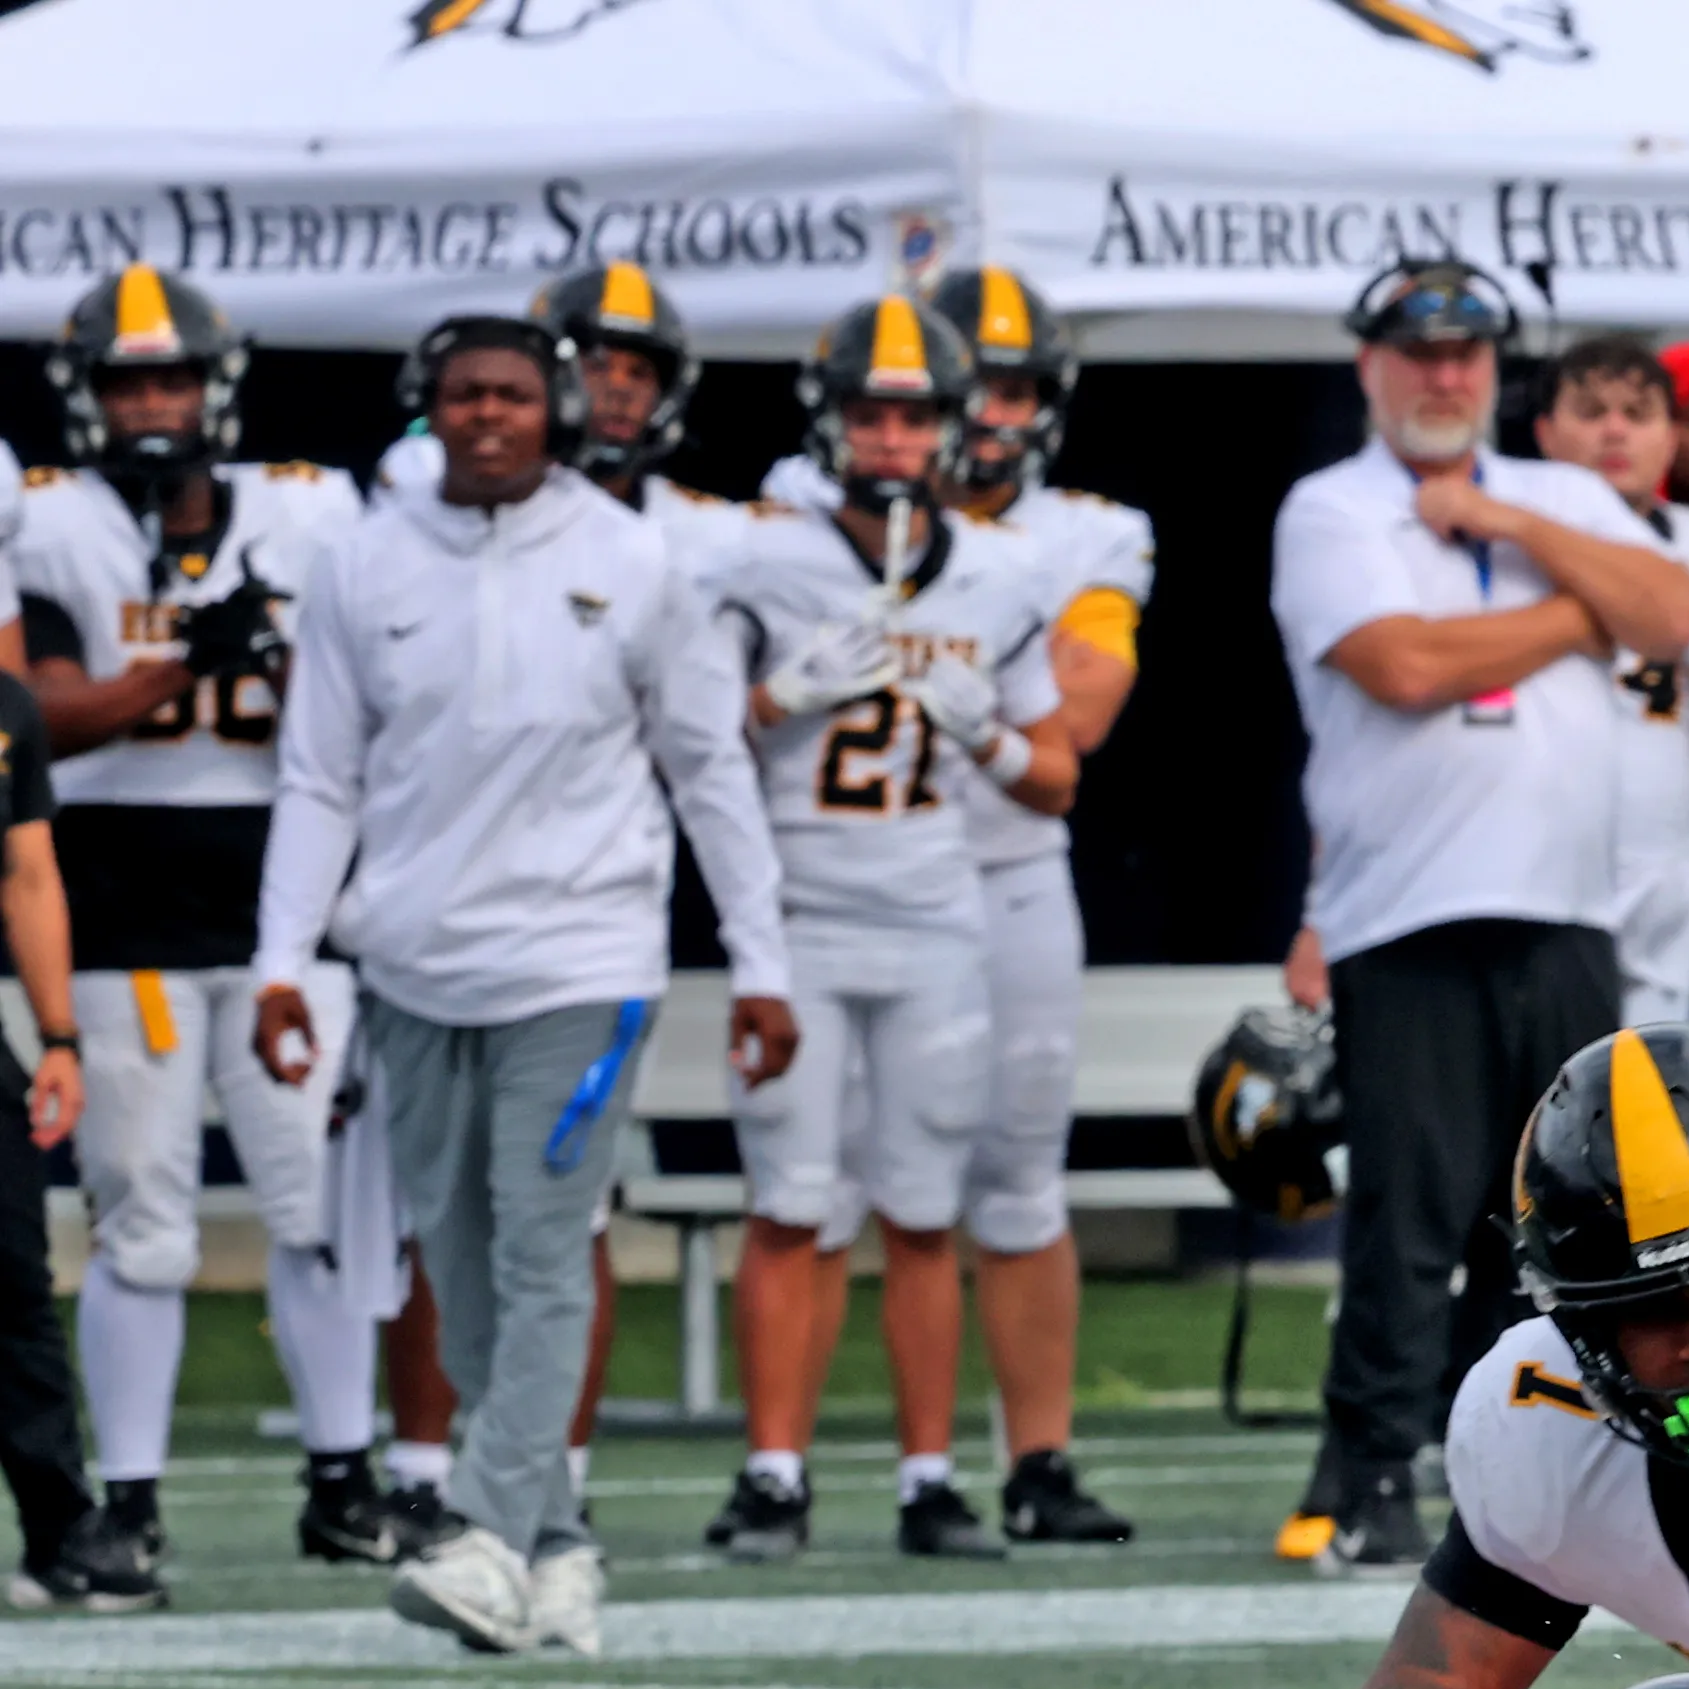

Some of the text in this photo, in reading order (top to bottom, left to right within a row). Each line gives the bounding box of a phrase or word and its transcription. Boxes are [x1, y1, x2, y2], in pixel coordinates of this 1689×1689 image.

[160, 184, 518, 274] HERITAGE
[534, 177, 870, 272] SCHOOLS
[1090, 174, 1462, 270] AMERICAN
